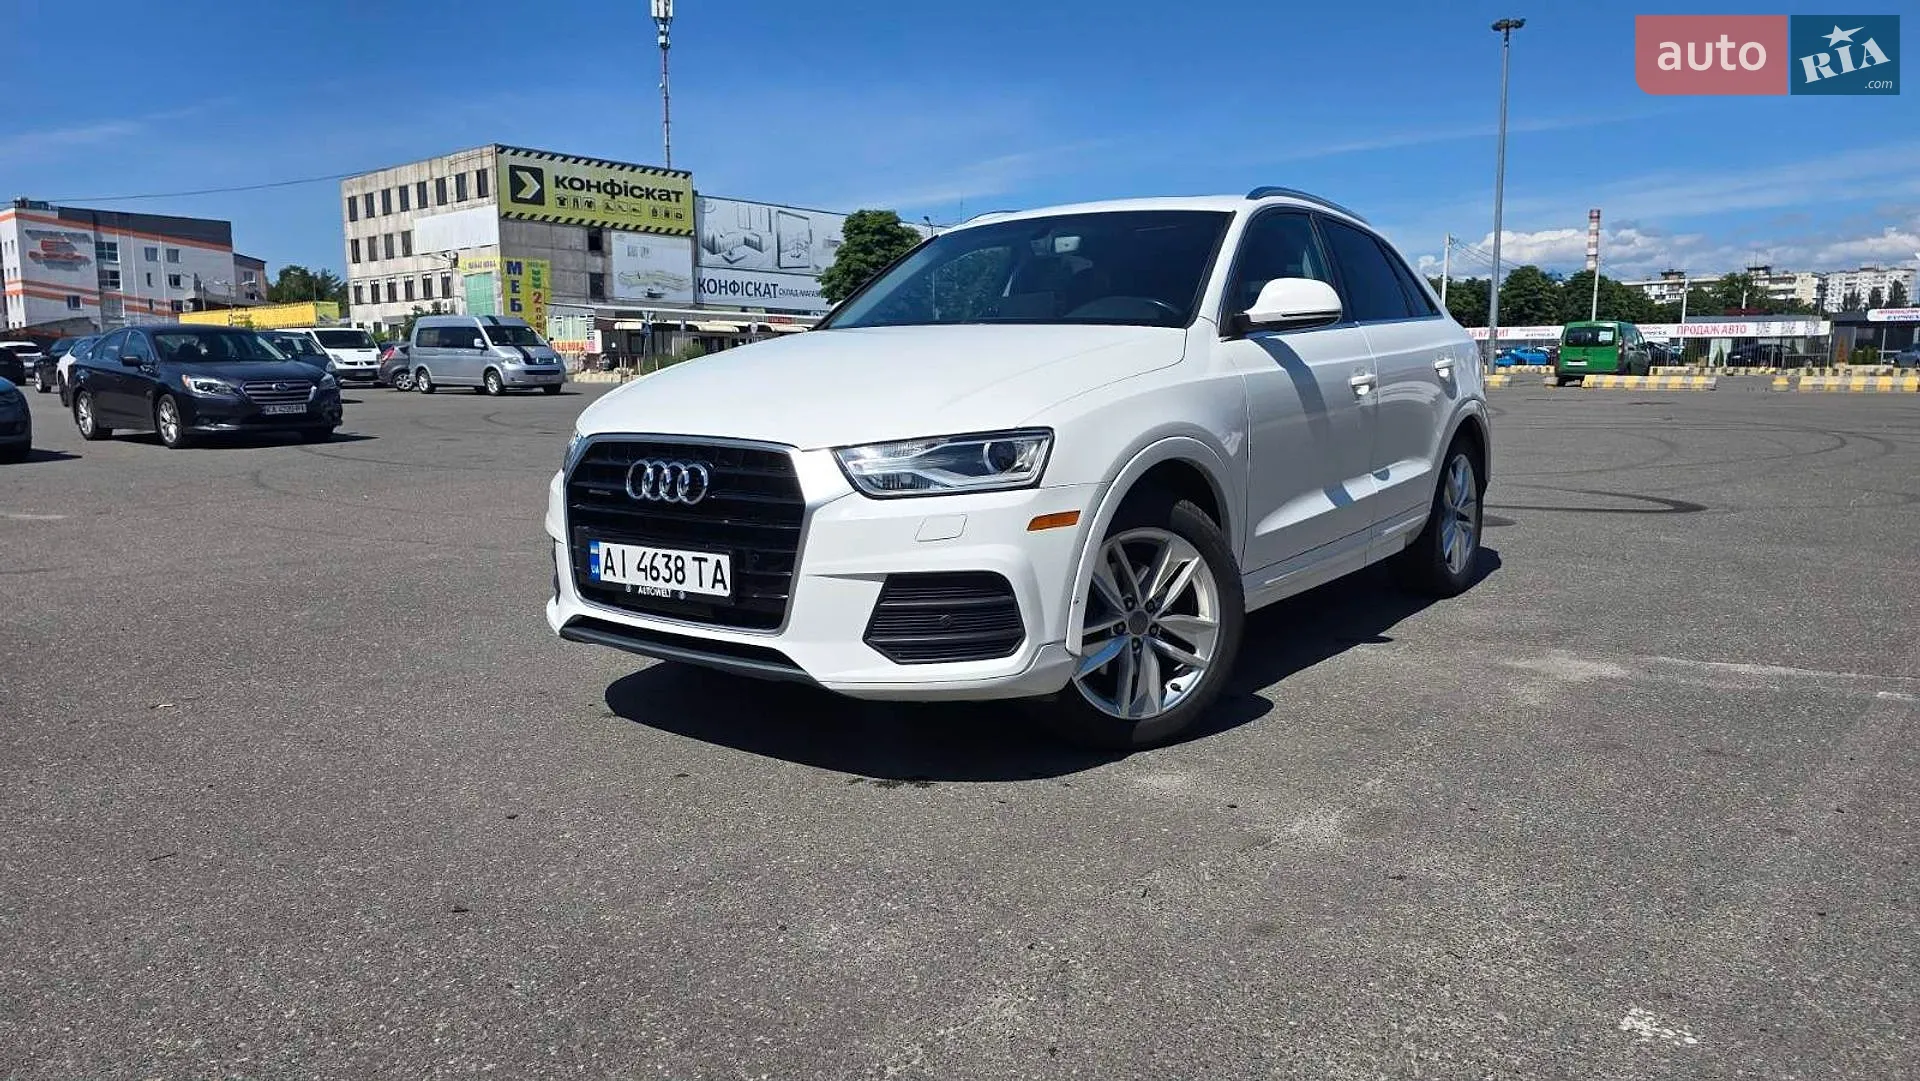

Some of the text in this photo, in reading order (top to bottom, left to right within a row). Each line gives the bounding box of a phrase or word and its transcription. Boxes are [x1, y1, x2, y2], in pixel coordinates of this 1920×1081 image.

[697, 278, 778, 299] КОНФІСКАТ
[1676, 325, 1719, 335] ПРОДАЖ
[1720, 324, 1747, 334] АВТО
[603, 547, 728, 590] AI 4638 TA
